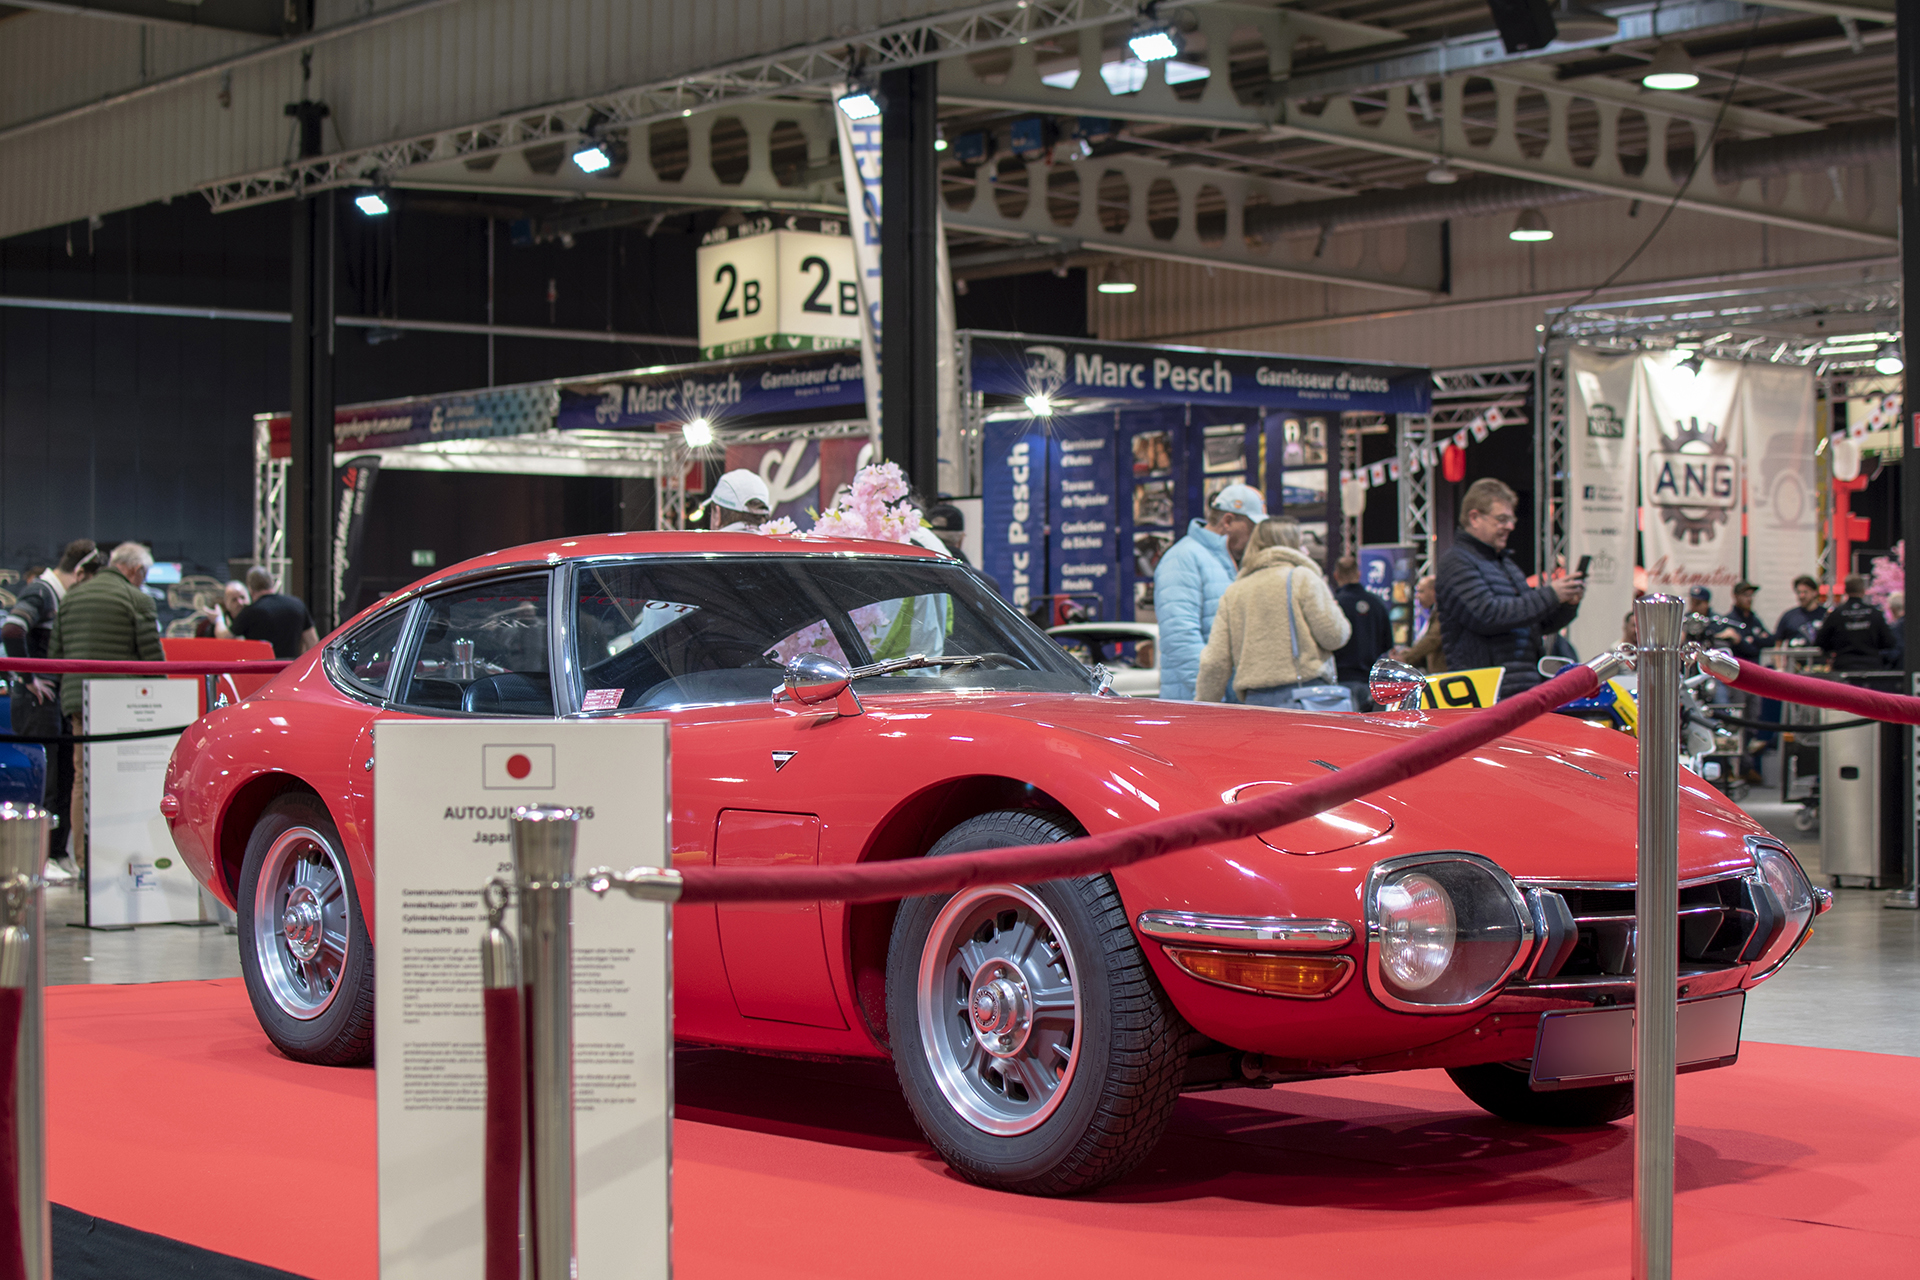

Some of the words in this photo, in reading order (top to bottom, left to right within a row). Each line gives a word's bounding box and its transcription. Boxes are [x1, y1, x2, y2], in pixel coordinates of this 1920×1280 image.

[714, 263, 762, 323] 2B
[800, 256, 859, 316] 2B
[627, 386, 677, 415] Marc
[682, 372, 742, 408] Pesch
[760, 369, 827, 391] Garnisseur
[828, 363, 866, 382] d'aut
[1075, 353, 1146, 389] Marc
[1154, 357, 1232, 394] Pesch
[1256, 366, 1334, 390] Garnisseur
[1336, 371, 1390, 394] d'autos
[1007, 442, 1030, 545] Pesch
[1655, 461, 1732, 497] ANG
